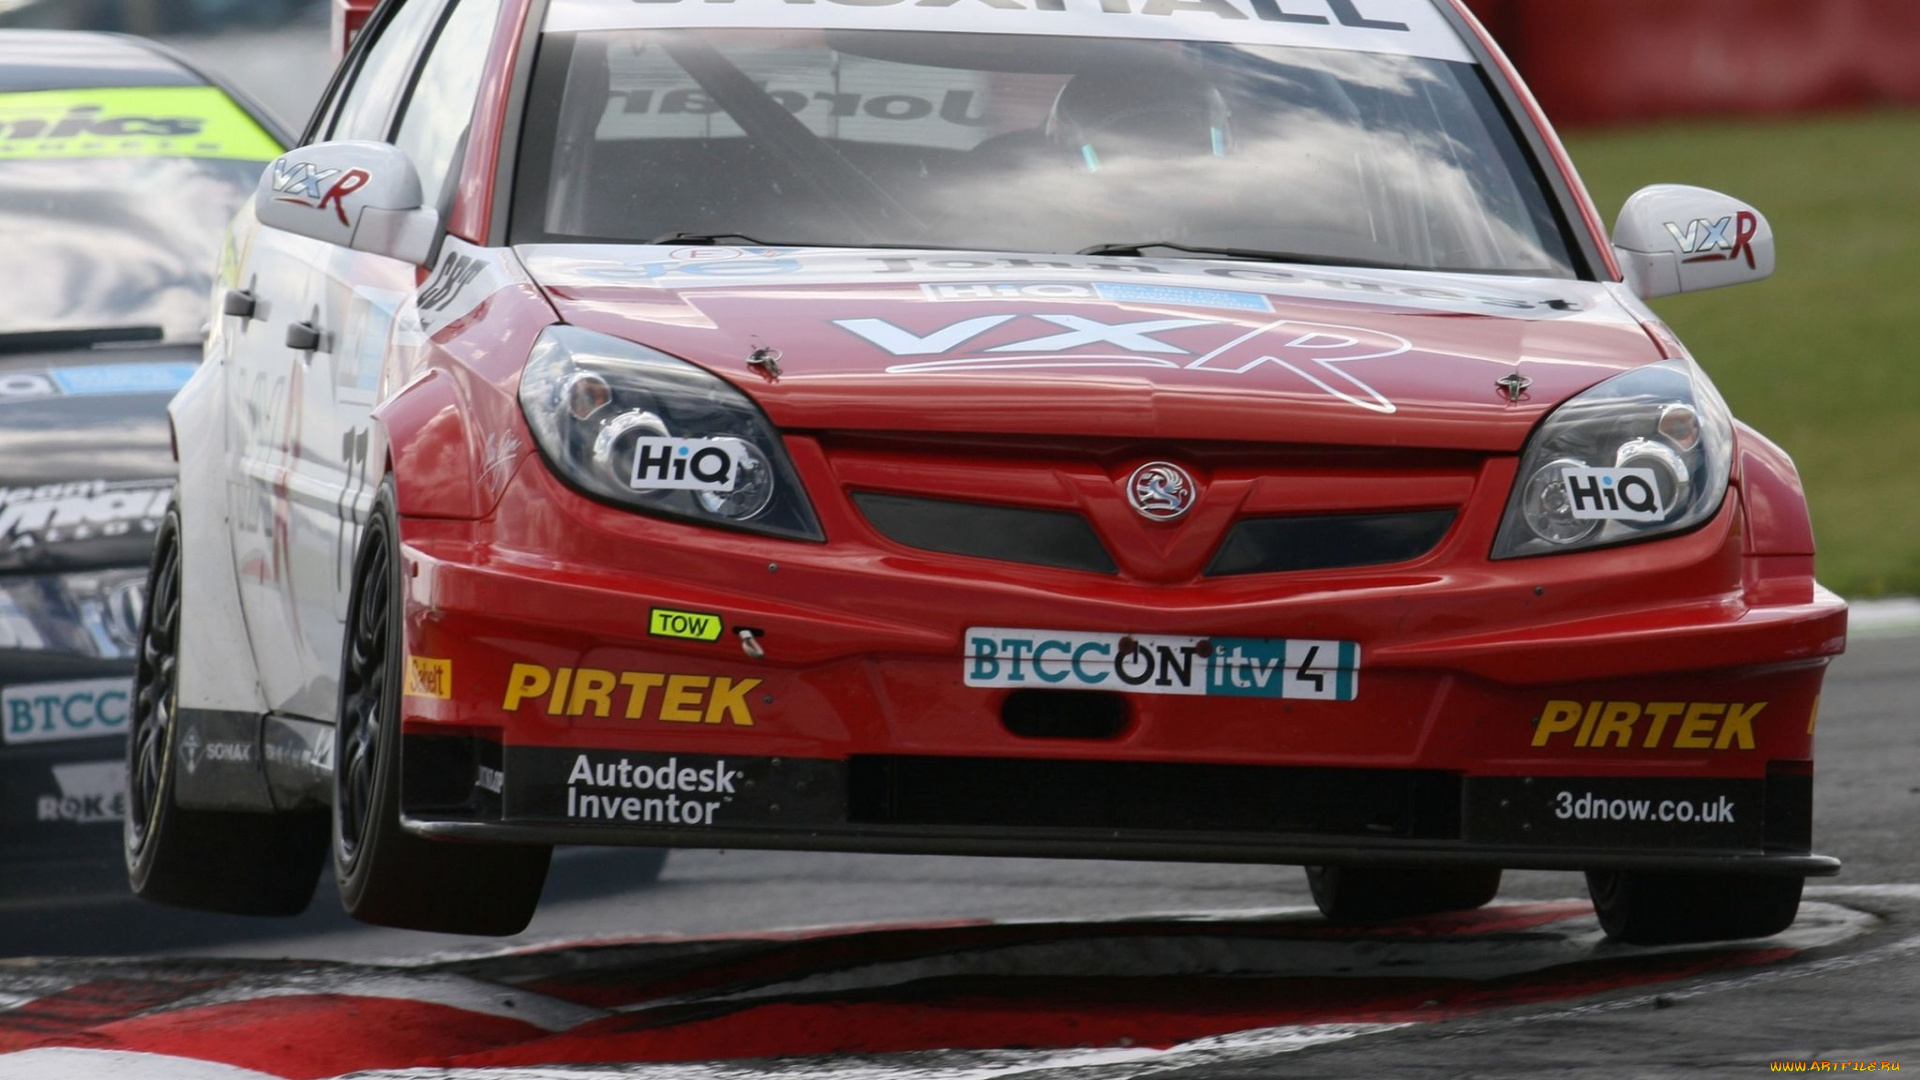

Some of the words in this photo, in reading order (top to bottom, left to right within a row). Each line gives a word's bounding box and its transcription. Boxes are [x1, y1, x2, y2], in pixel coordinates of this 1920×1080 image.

[272, 158, 372, 227] VXR
[1663, 210, 1757, 271] VXR
[866, 257, 1172, 275] John
[829, 313, 1413, 414] VXR
[637, 445, 731, 486] HiQ
[1568, 474, 1658, 514] HiQ
[659, 614, 709, 637] TOW
[1213, 644, 1279, 688] itv
[1296, 645, 1324, 692] 4
[8, 690, 128, 734] BTCC
[502, 662, 764, 726] PIRTEK
[1531, 700, 1769, 750] PIRTEK
[567, 754, 737, 793] Autodesk
[567, 786, 721, 825] Inventor
[1555, 791, 1735, 823] 3dnow.co.uk
